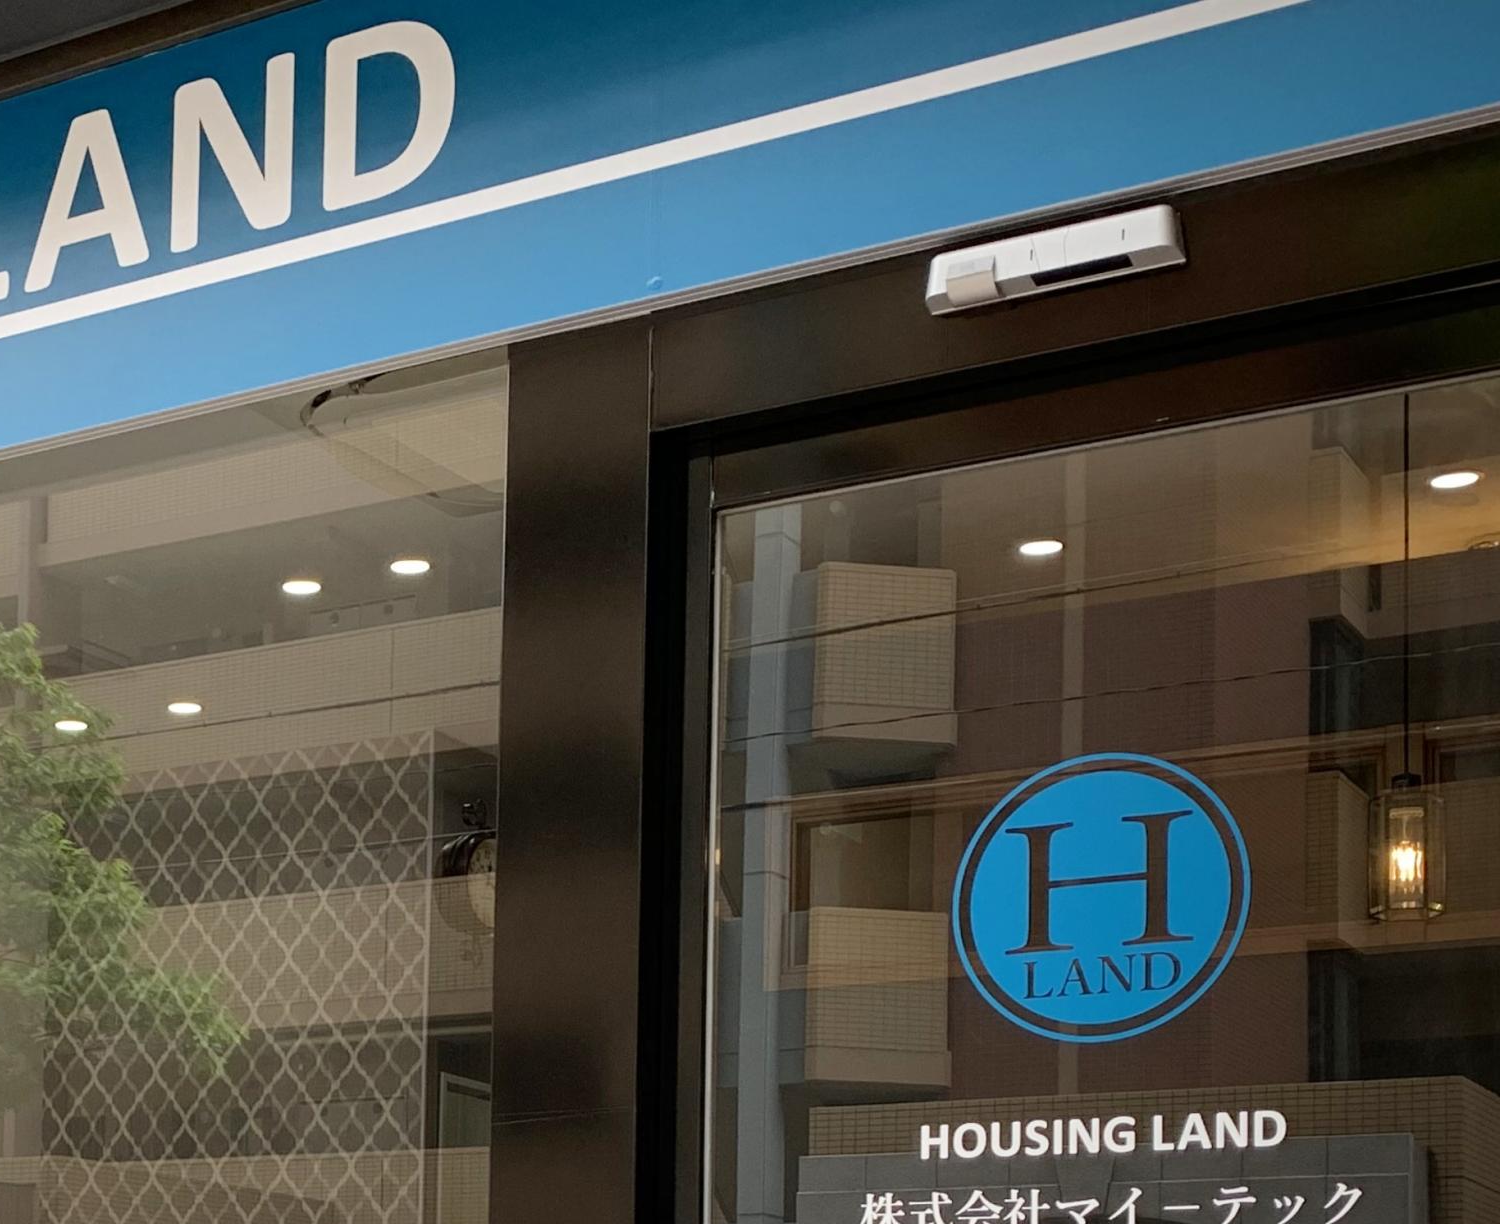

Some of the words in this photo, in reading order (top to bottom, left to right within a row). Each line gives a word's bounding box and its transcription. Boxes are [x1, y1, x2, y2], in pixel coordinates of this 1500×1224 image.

[1004, 808, 1195, 956] H
[1022, 951, 1182, 1000] LAND
[919, 1114, 1137, 1160] HOUSING
[1151, 1109, 1288, 1152] LAND
